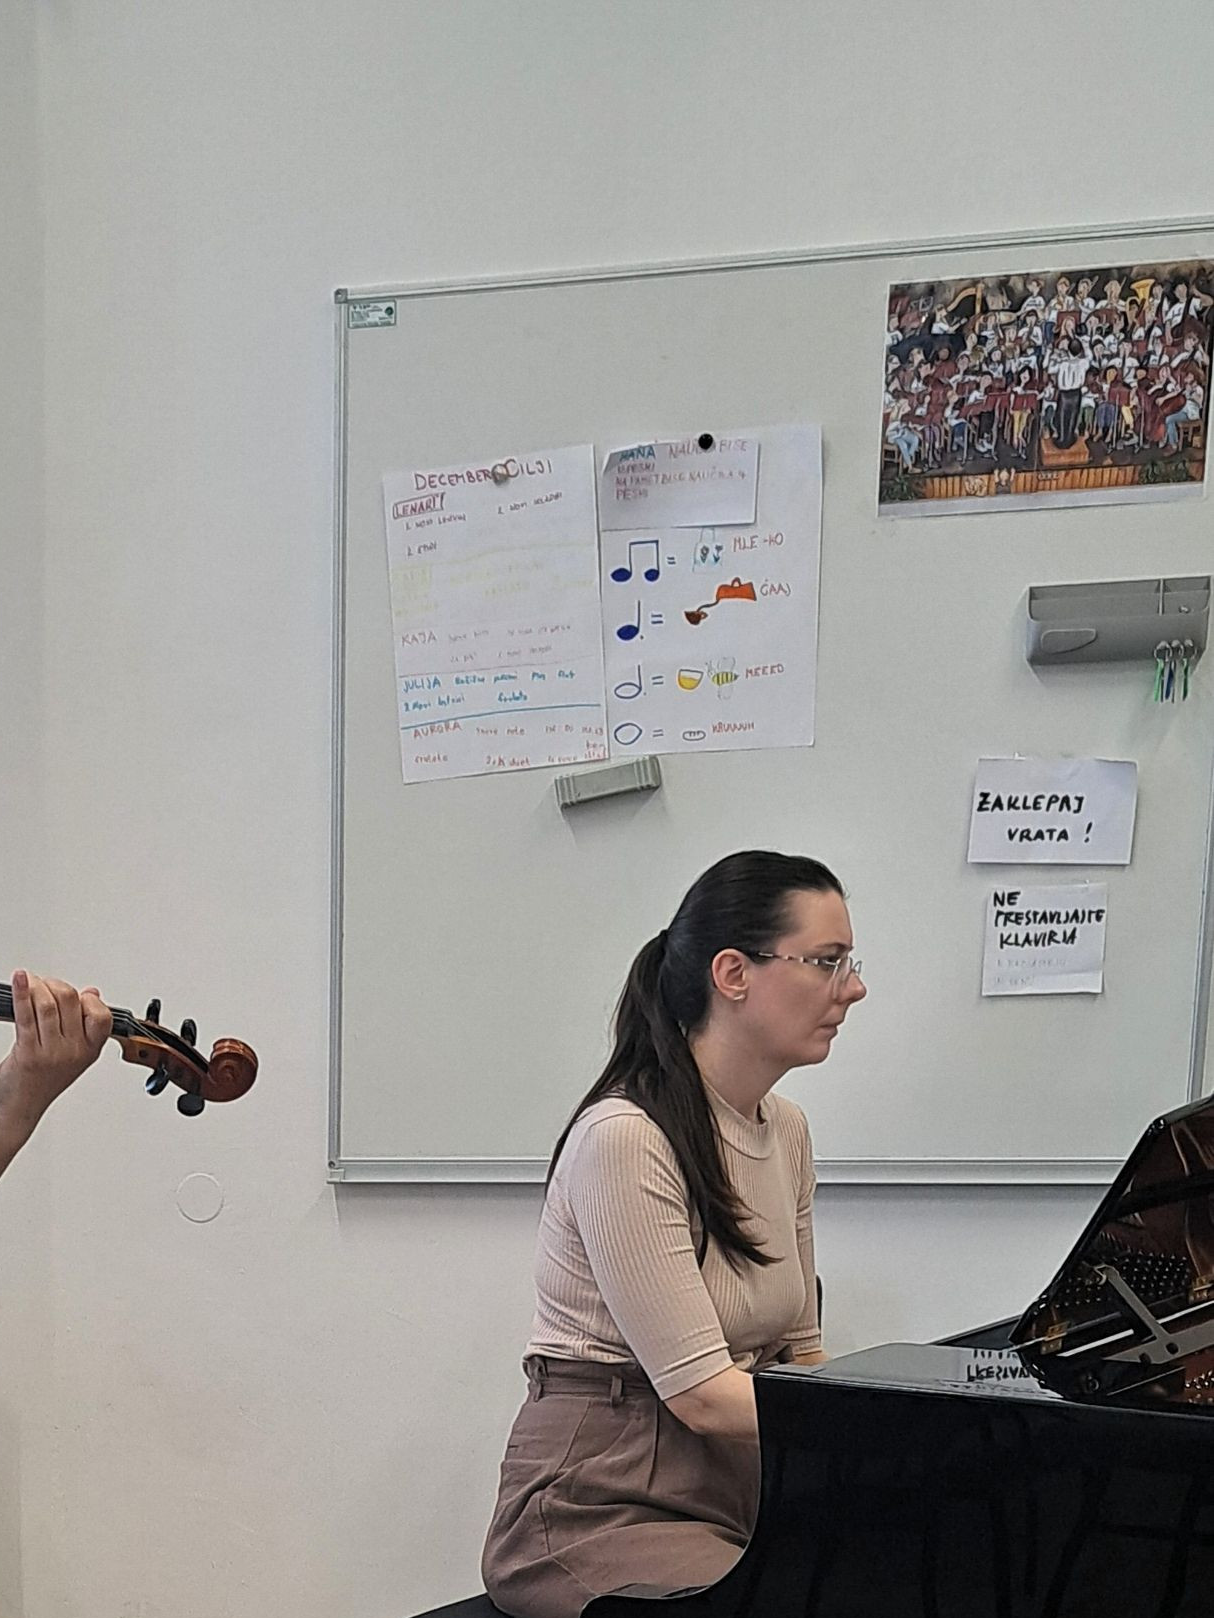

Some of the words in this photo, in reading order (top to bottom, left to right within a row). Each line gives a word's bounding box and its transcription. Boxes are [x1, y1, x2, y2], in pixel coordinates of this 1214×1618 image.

[505, 458, 553, 478] CILJI
[401, 631, 438, 647] KAJA
[403, 676, 442, 693] JULIJA
[413, 721, 462, 739] AURORA
[976, 791, 1085, 815] ZAKLEPAJ
[1007, 827, 1069, 843] VRATA
[993, 890, 1022, 907] NE
[999, 926, 1078, 950] KLAVIRJA
